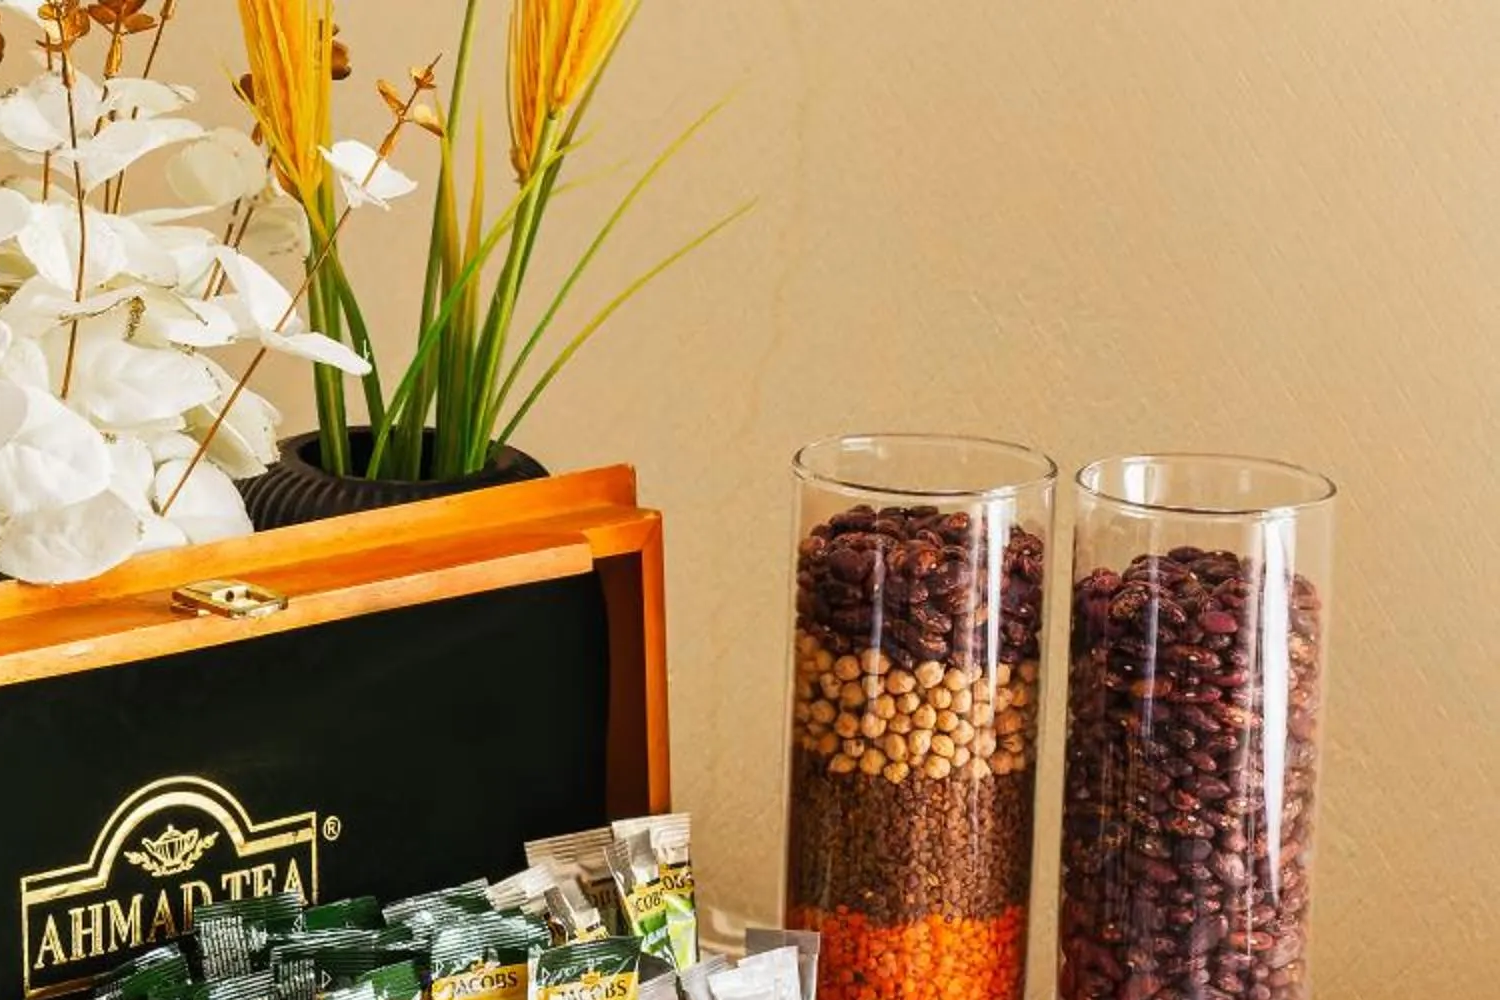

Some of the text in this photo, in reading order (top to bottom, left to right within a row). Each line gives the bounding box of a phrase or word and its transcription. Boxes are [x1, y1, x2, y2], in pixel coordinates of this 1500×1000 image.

[34, 857, 310, 970] AHMAD TEA
[449, 971, 519, 1000] JACOBS
